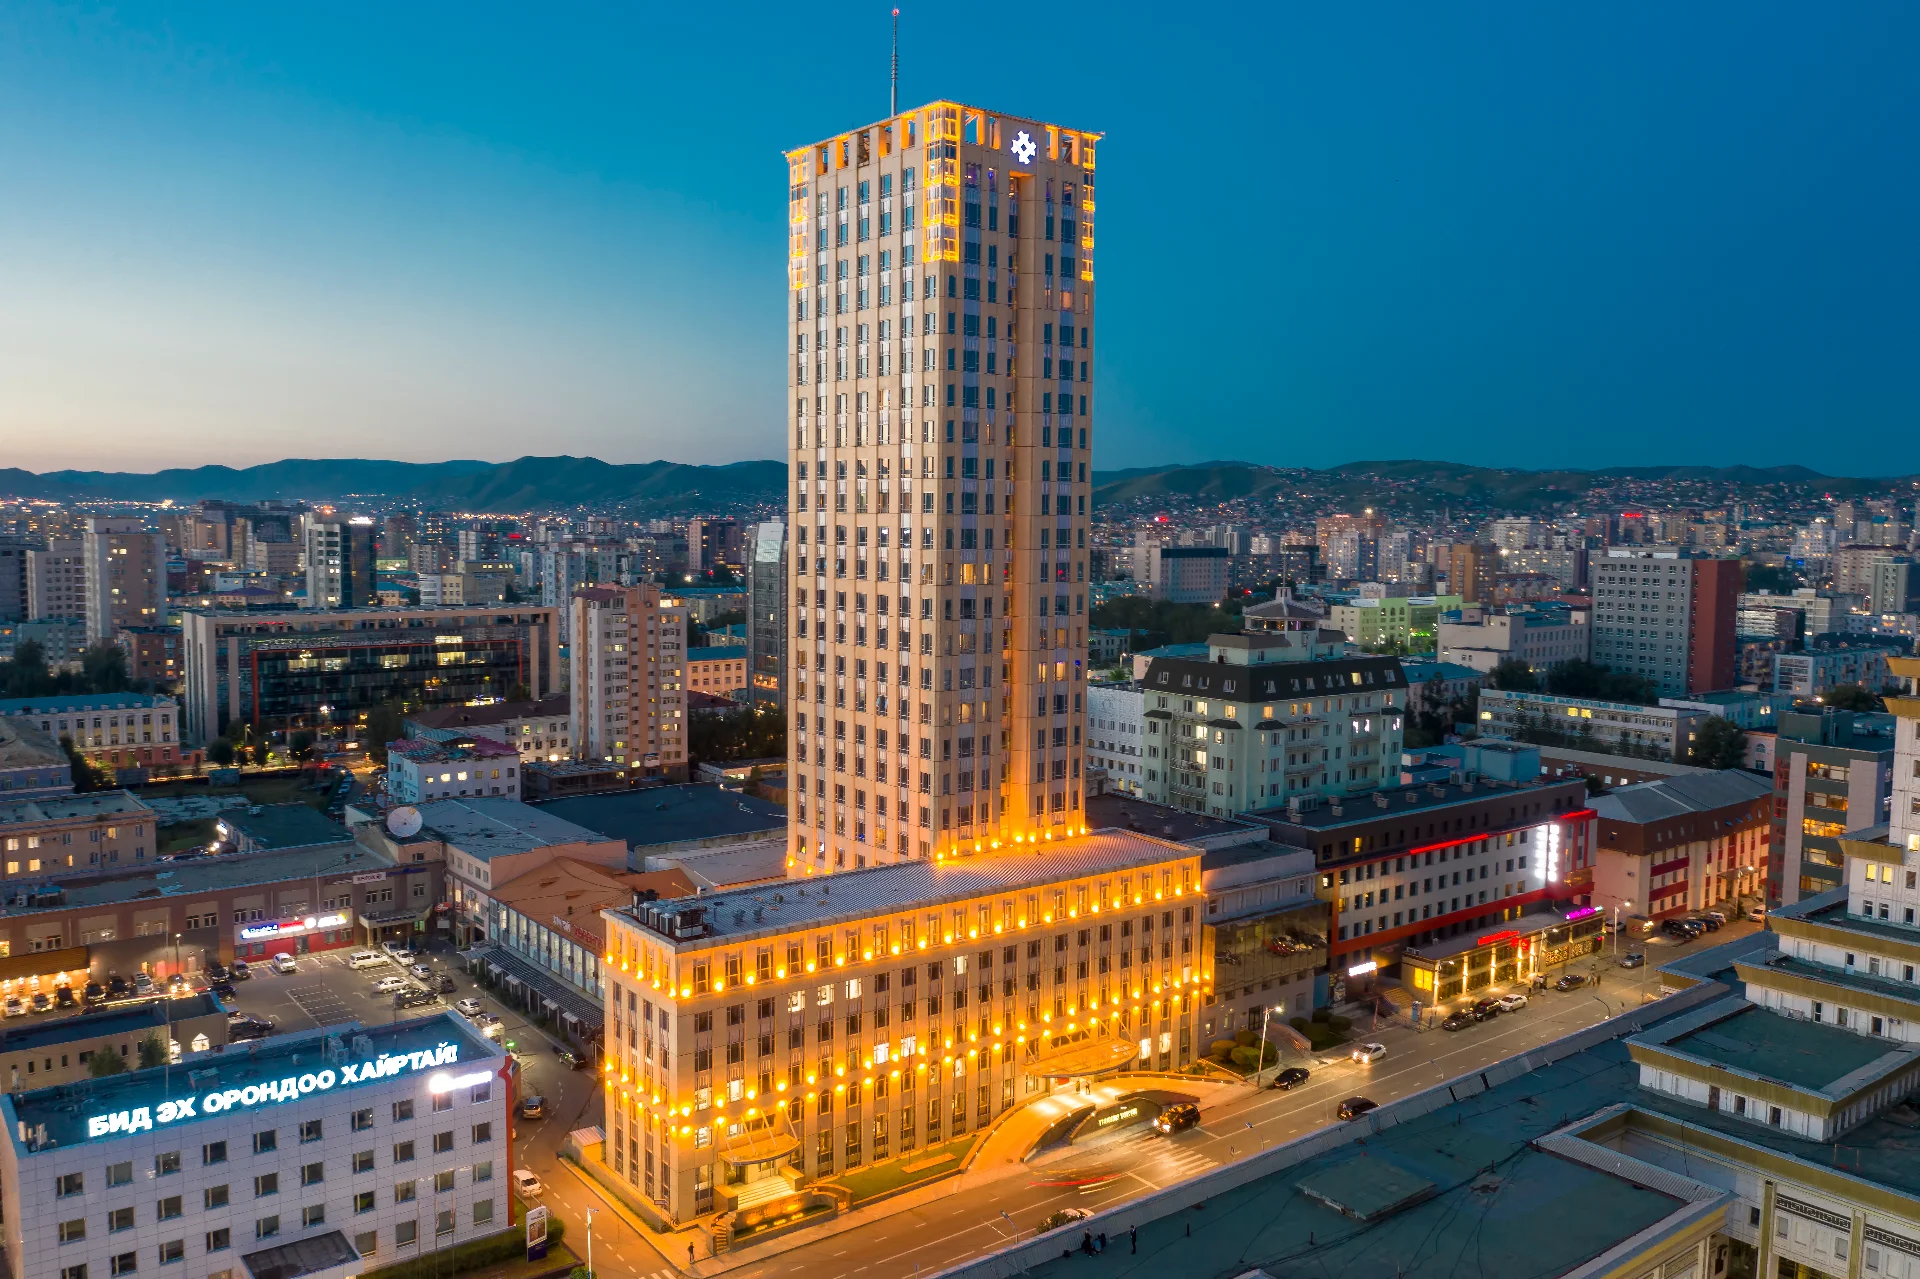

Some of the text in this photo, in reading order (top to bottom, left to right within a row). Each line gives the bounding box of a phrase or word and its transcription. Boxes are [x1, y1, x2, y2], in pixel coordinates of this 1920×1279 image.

[89, 1106, 153, 1138] БИД
[157, 1096, 197, 1123] ЭХ
[203, 1069, 336, 1113] ОРОНДОО
